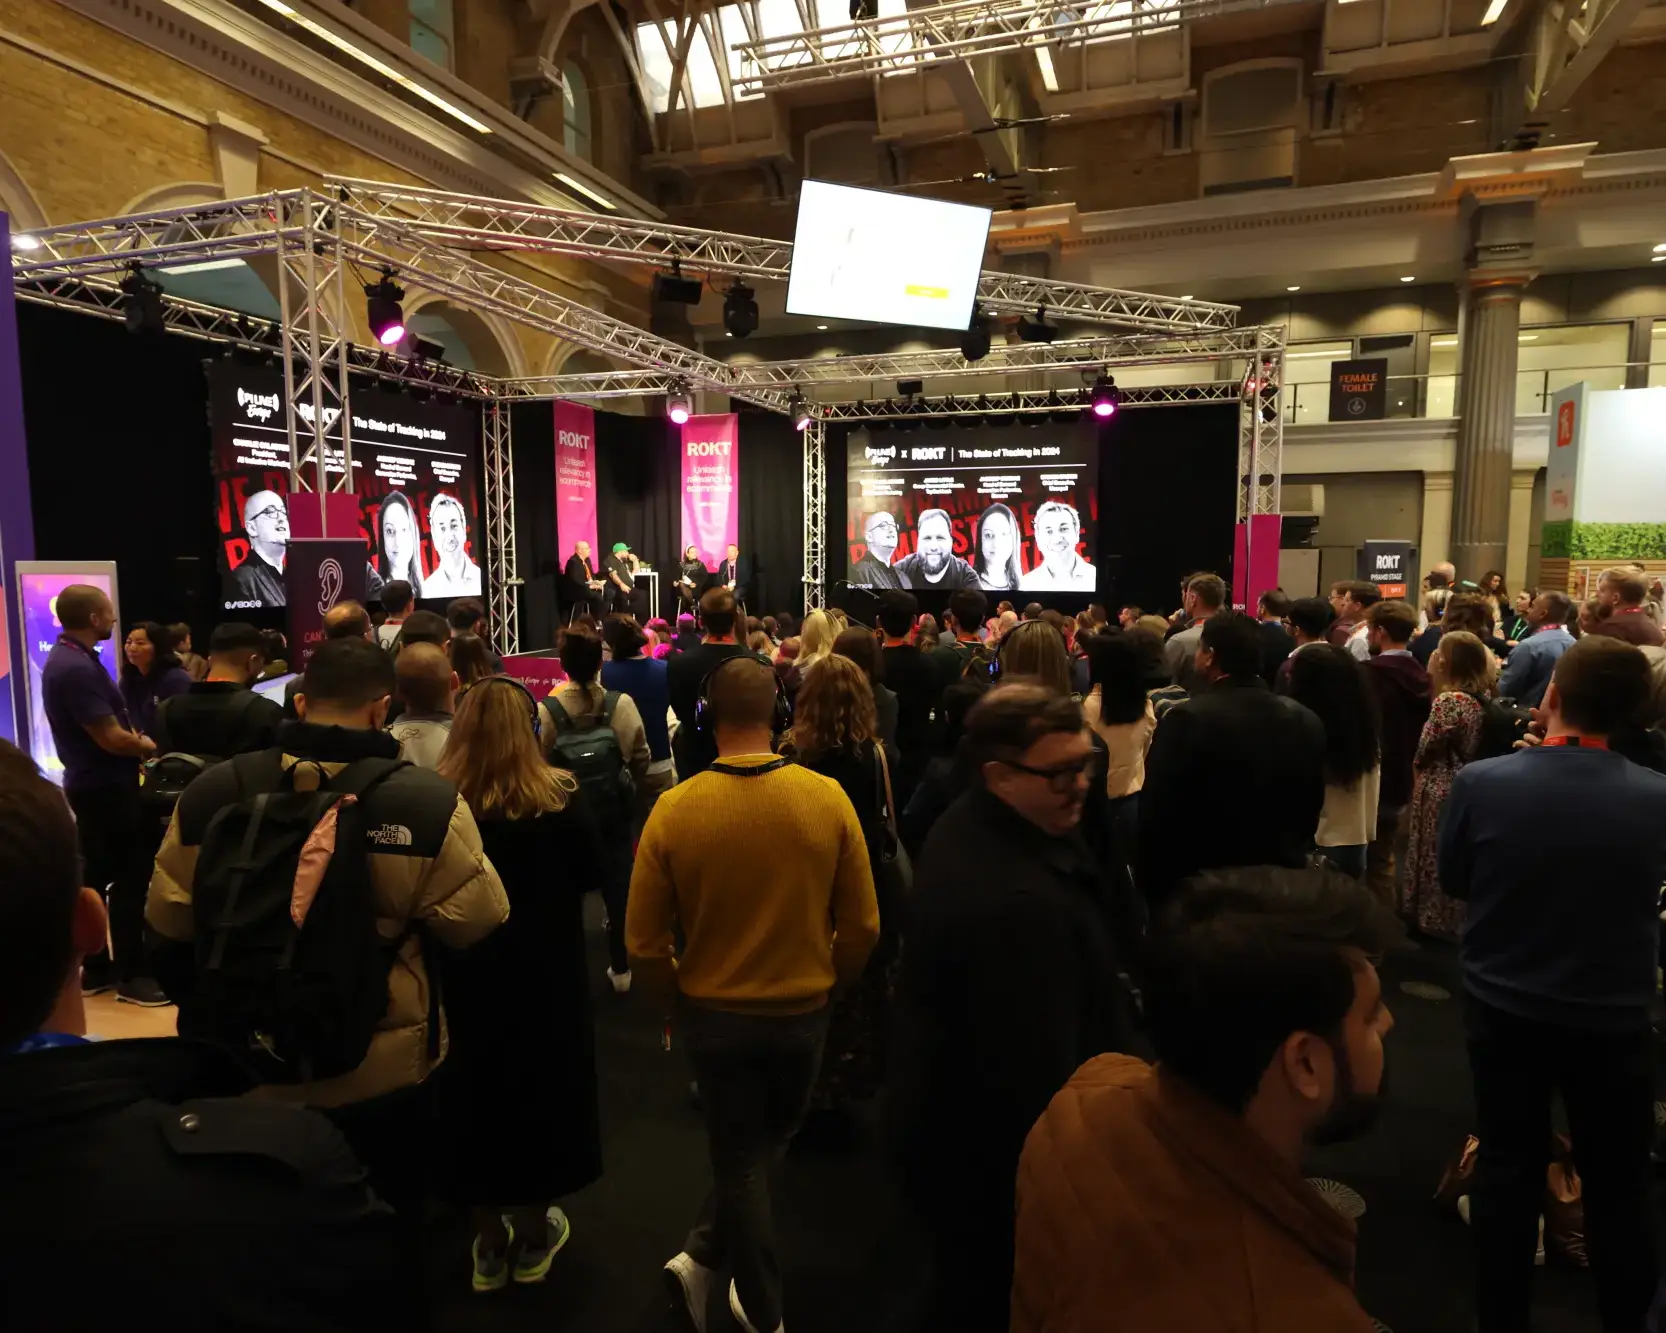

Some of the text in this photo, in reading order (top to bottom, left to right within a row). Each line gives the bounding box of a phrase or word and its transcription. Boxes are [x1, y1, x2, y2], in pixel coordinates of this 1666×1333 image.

[1340, 373, 1378, 383] FEMALE
[1342, 383, 1376, 393] TOILET
[253, 394, 273, 407] LIVE
[352, 416, 367, 429] The
[368, 419, 387, 432] State
[388, 423, 396, 432] of
[396, 423, 423, 439] Tracking
[423, 428, 430, 438] in
[559, 429, 590, 450] ROKT
[687, 442, 732, 457] ROKT
[912, 447, 946, 460] ROKT
[958, 449, 973, 458] The
[973, 449, 993, 458] State
[993, 448, 1001, 457] of
[1002, 447, 1032, 458] Tracking
[1033, 447, 1040, 456] in
[1041, 447, 1060, 456] 2024
[1376, 555, 1401, 569] ROKT
[1389, 573, 1403, 581] STAGE
[367, 830, 398, 838] NORTH
